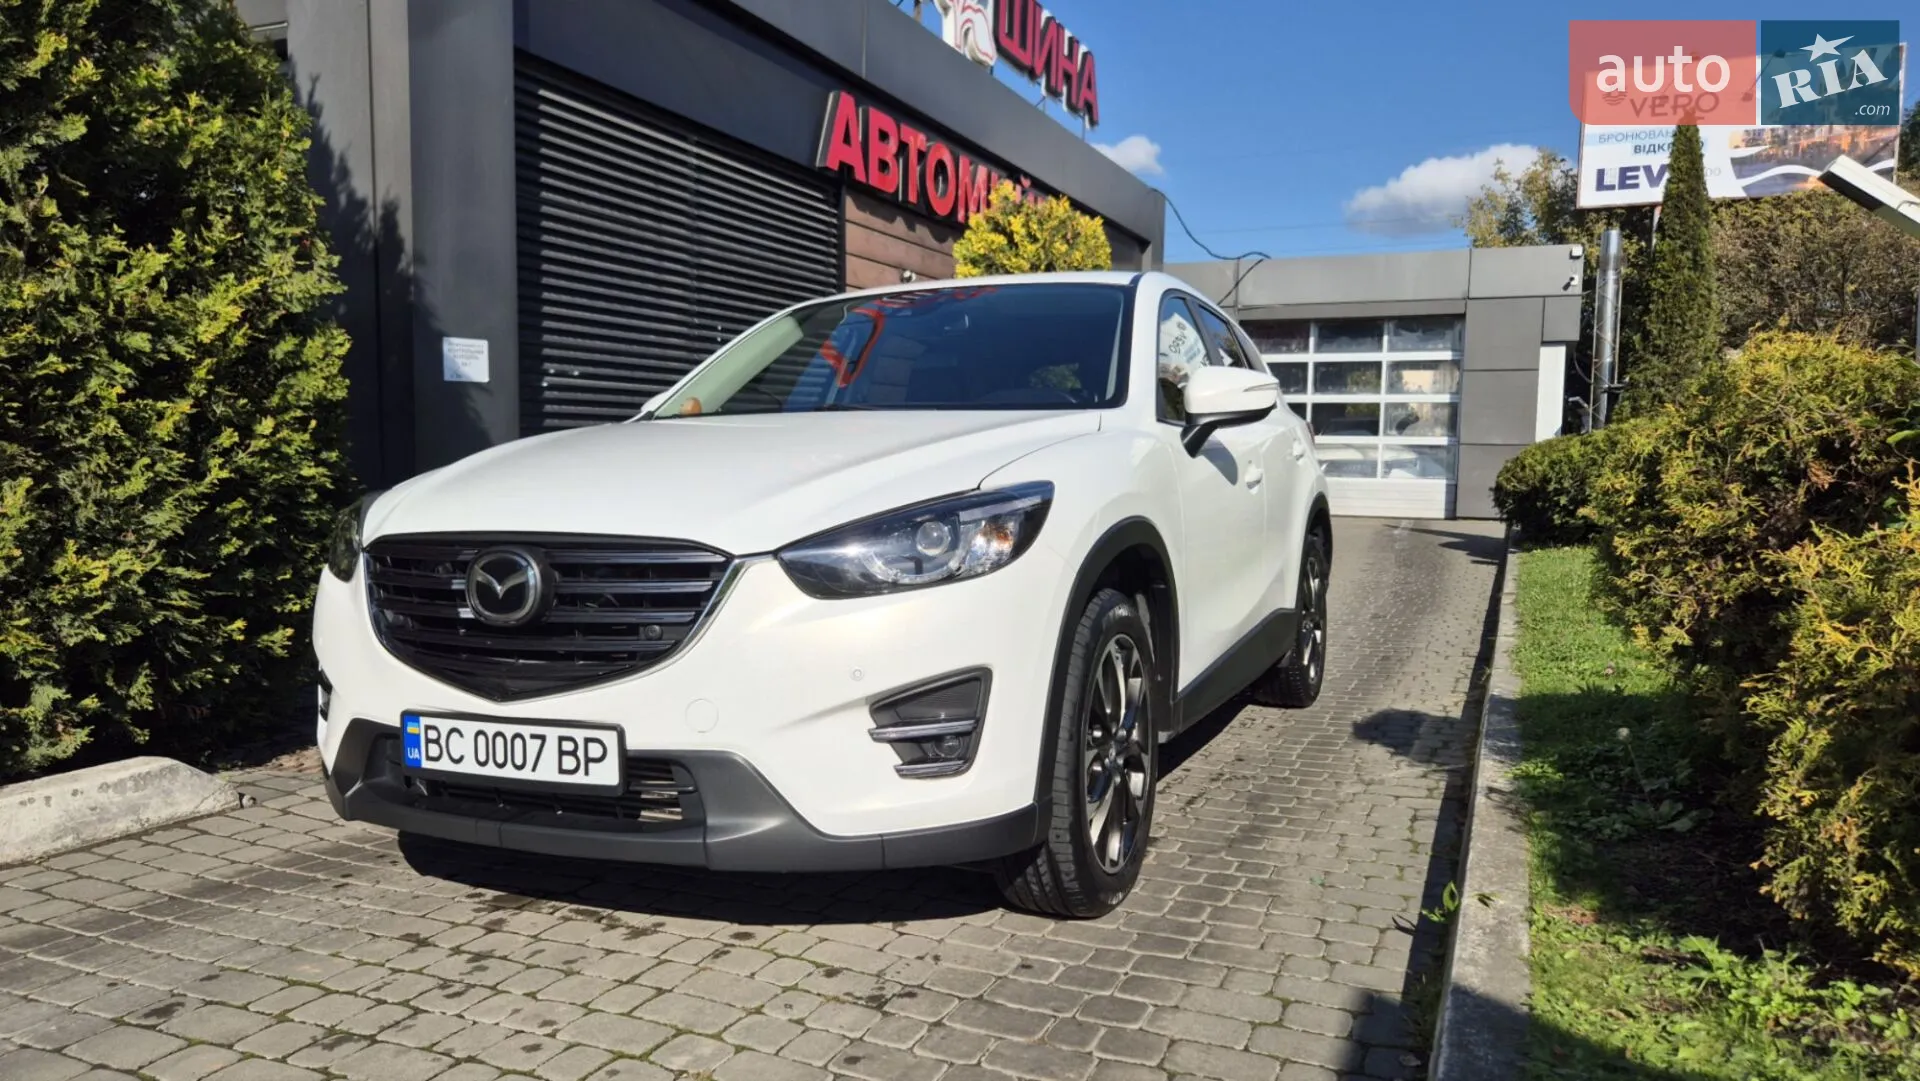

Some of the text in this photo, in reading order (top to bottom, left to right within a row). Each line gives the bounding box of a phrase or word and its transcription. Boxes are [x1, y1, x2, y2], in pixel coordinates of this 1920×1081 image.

[997, 0, 1098, 128] ШИНА
[407, 746, 420, 760] UA
[423, 723, 608, 776] BC 0007 BP
